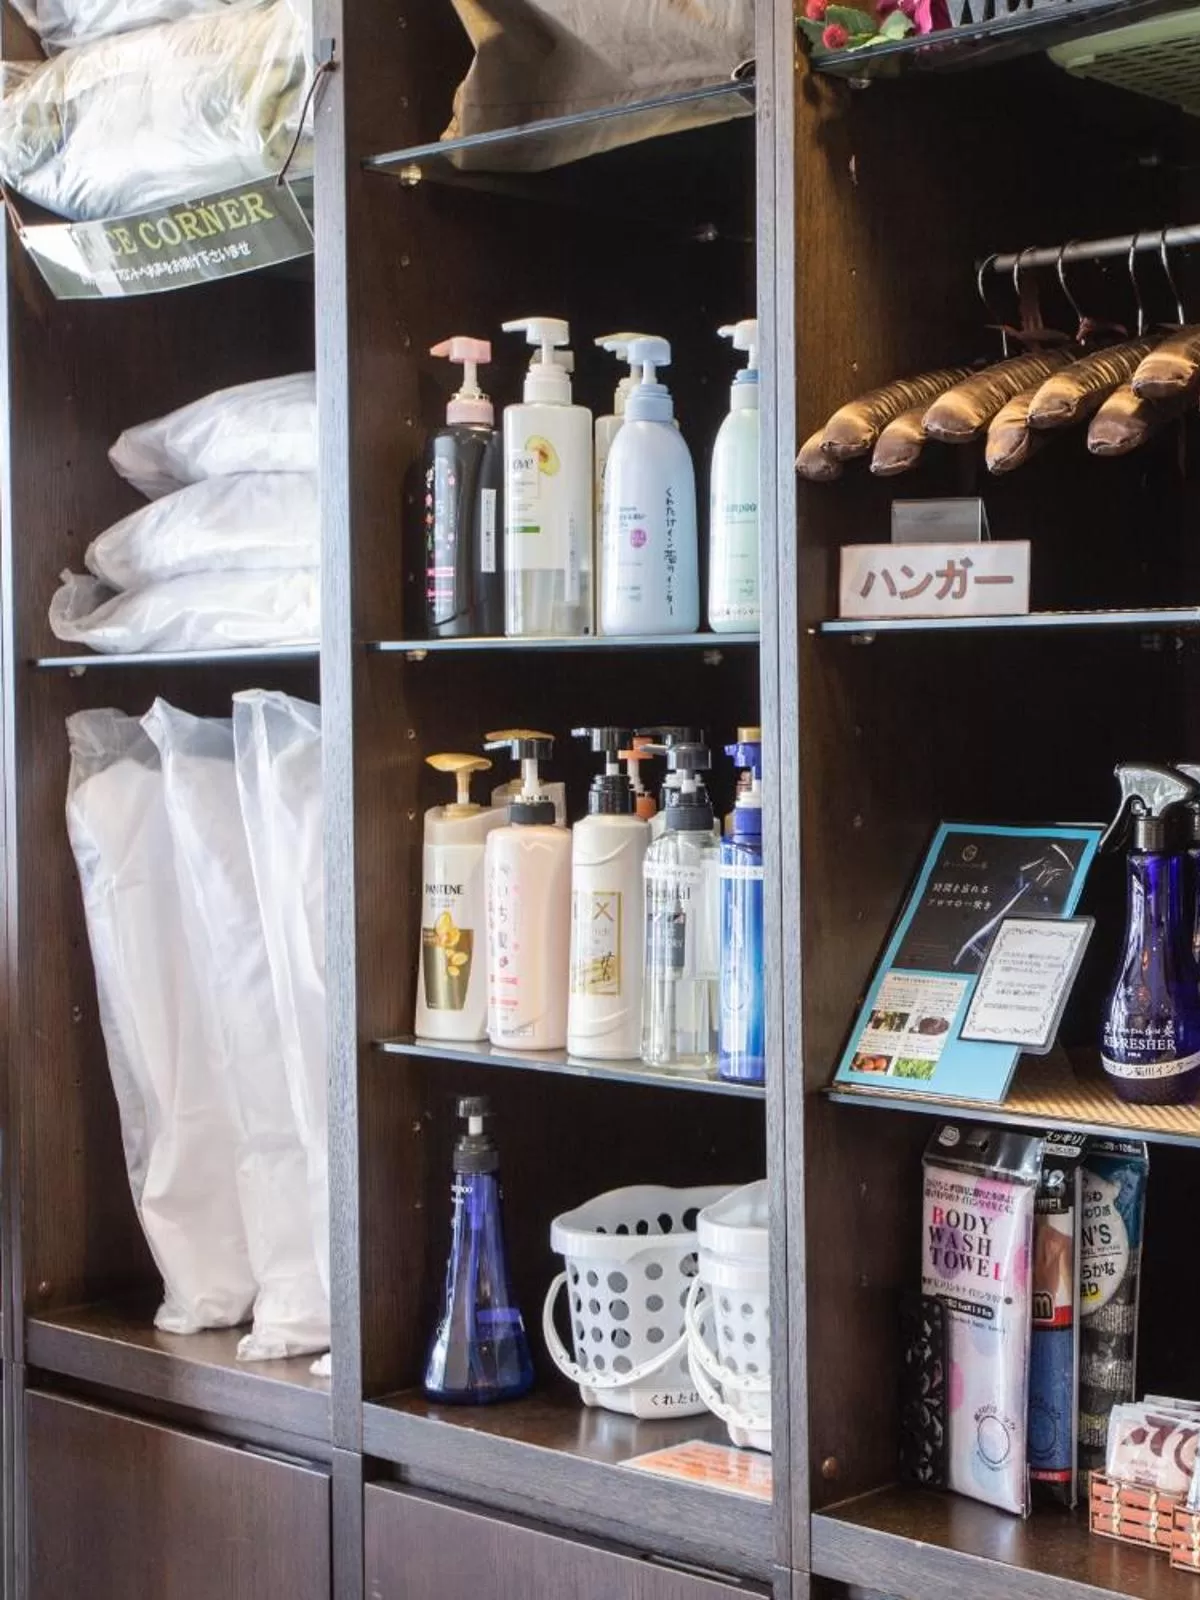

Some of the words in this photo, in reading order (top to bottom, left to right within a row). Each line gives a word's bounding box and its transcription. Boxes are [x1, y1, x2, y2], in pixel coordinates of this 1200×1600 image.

[138, 192, 275, 249] CORNER
[860, 557, 1014, 600] ハンガー
[425, 884, 464, 896] PANTENE
[932, 1206, 993, 1235] BODY
[929, 1226, 993, 1257] WASH
[929, 1247, 1001, 1281] TOWEL
